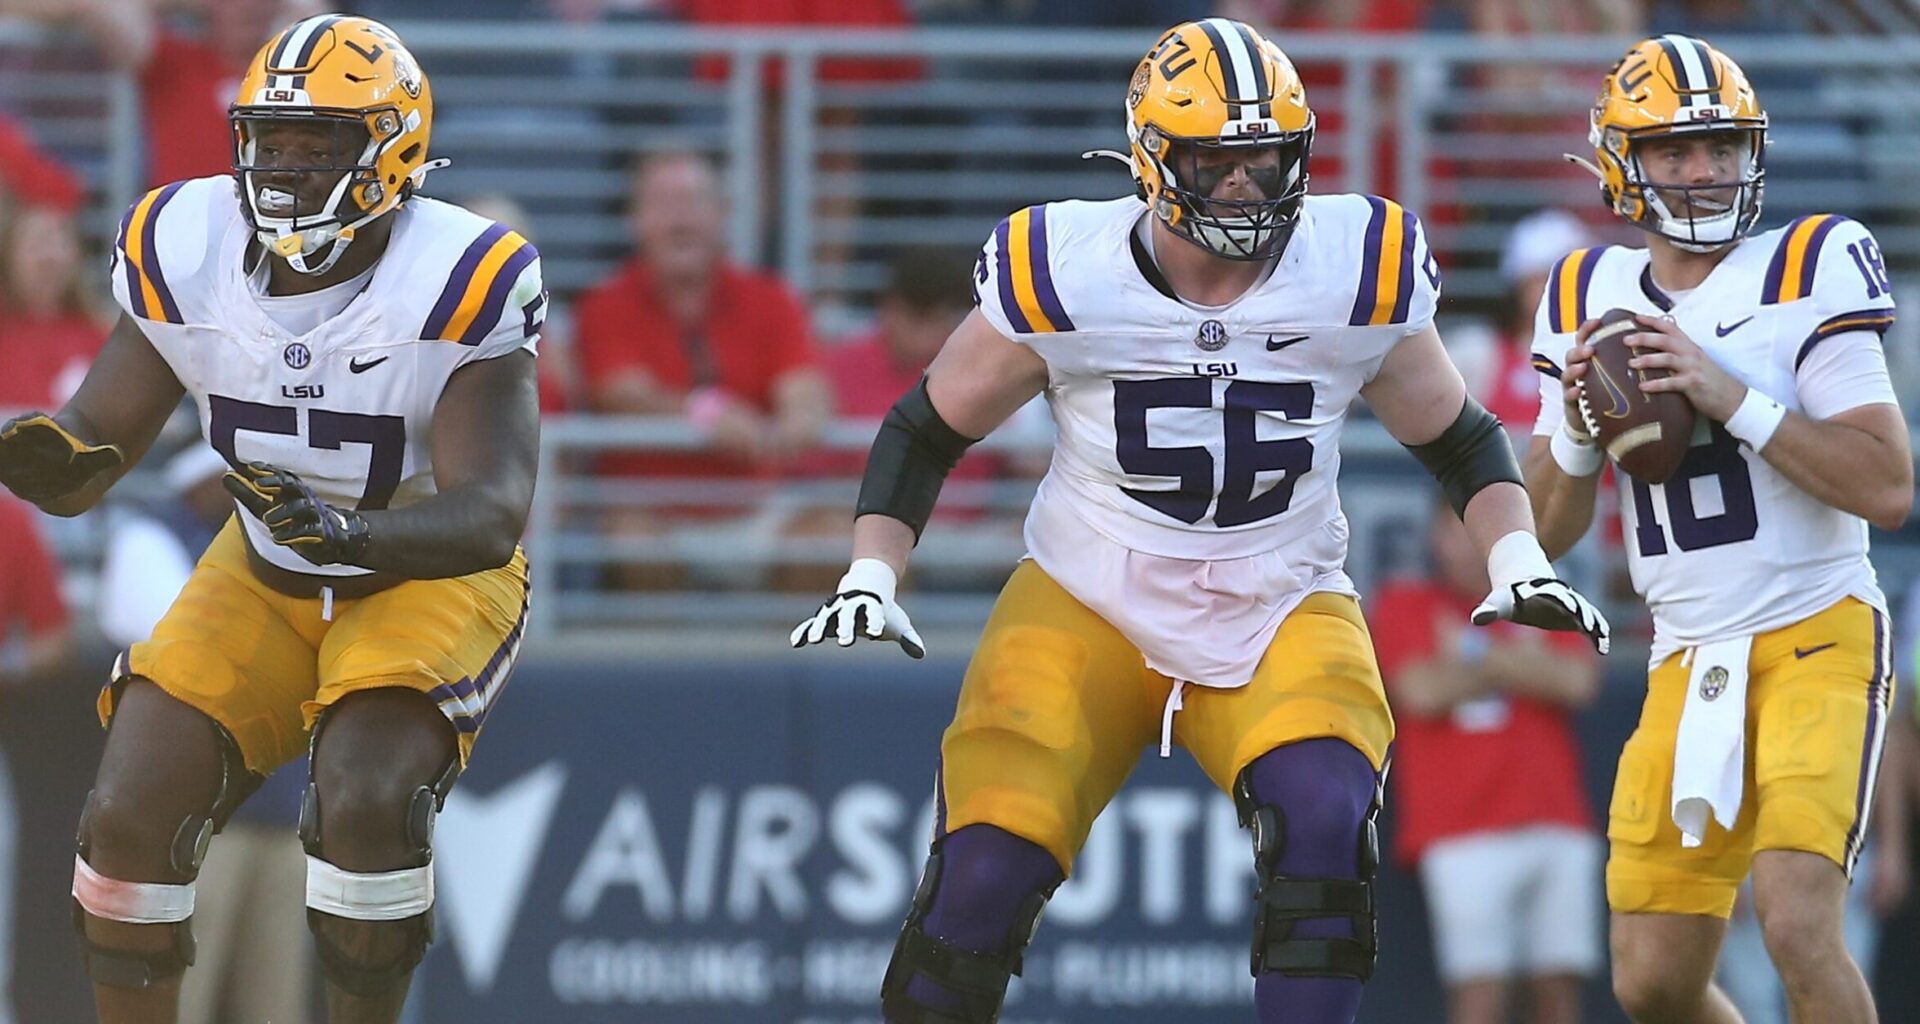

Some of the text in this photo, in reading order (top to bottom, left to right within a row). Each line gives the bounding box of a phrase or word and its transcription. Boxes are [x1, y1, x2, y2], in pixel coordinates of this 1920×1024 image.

[265, 91, 295, 102] LSU
[1689, 109, 1720, 121] LSU
[1237, 122, 1268, 135] LSU
[1846, 237, 1890, 299] 18
[1201, 321, 1223, 344] SEC
[286, 346, 309, 368] SEC
[1193, 362, 1239, 377] LSU
[281, 384, 325, 399] LSU
[1112, 377, 1315, 528] 56
[560, 780, 1257, 926] AIRSUTH
